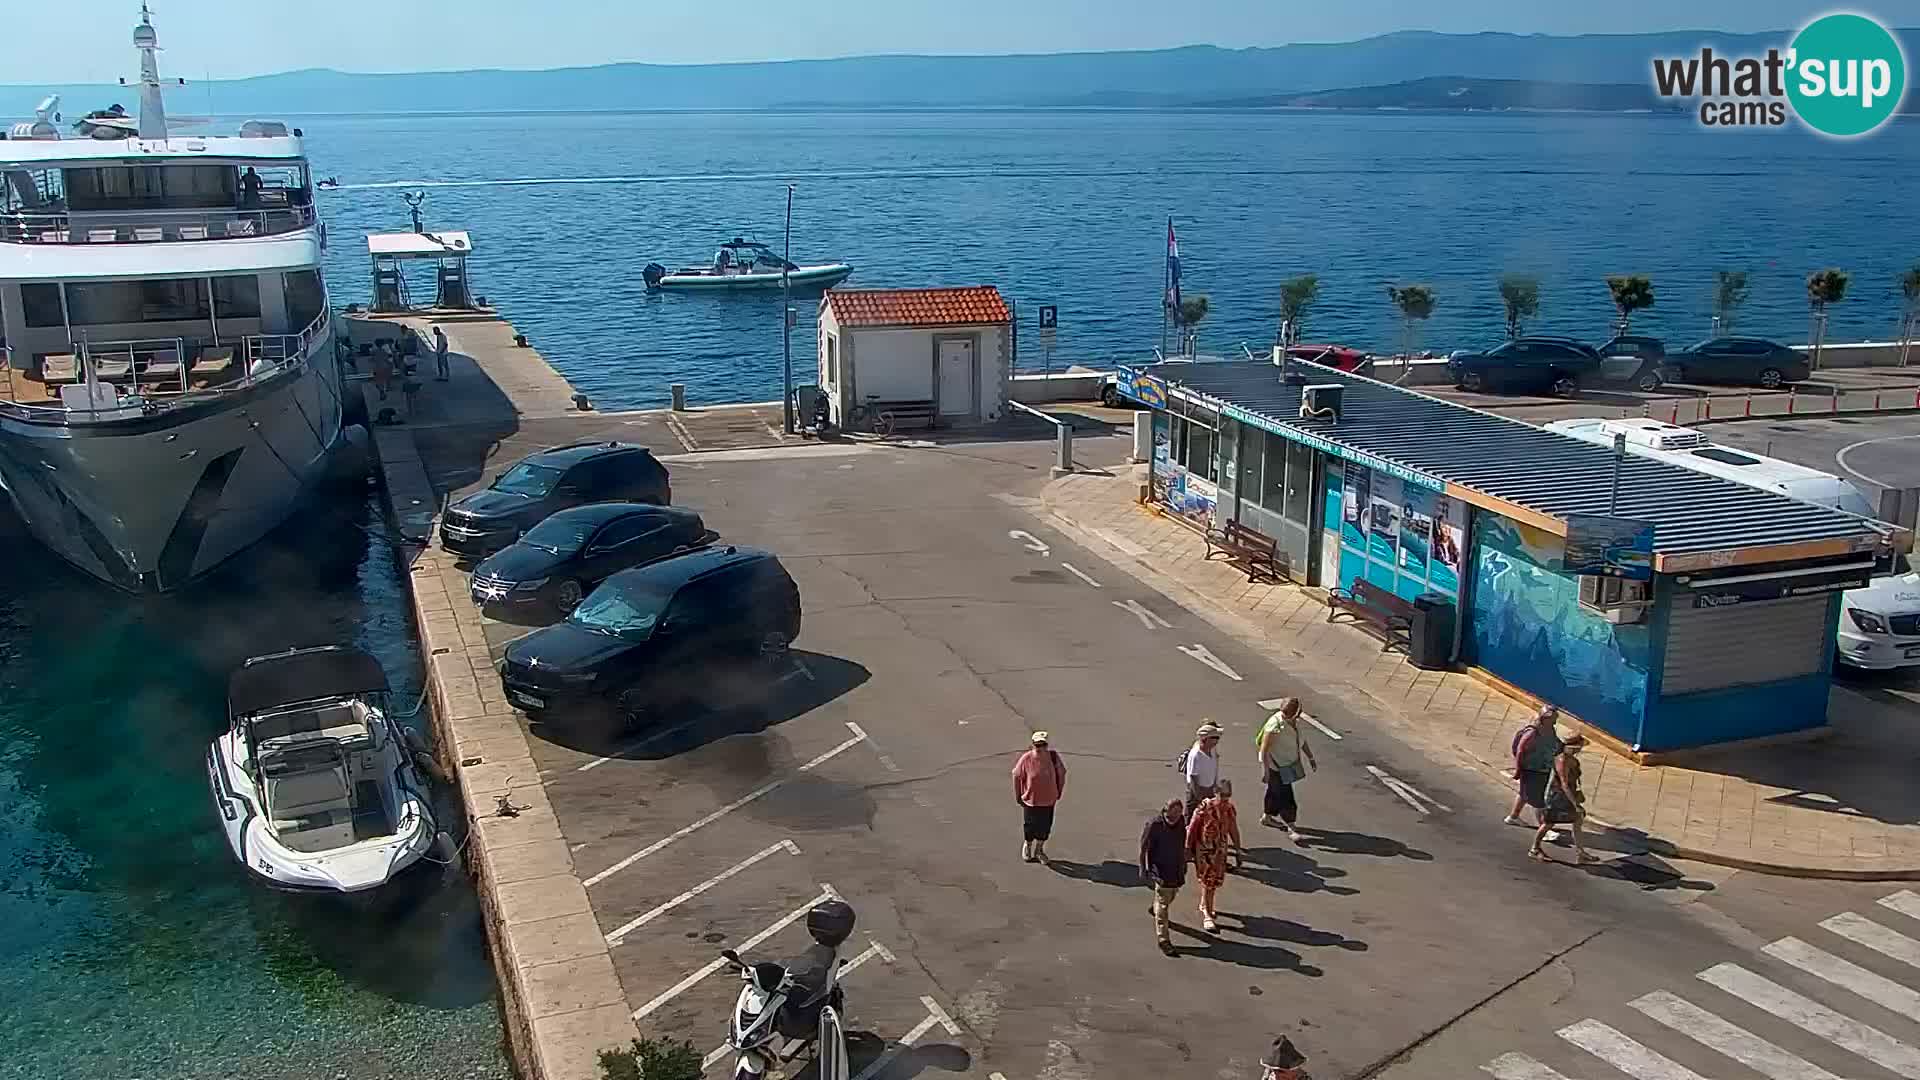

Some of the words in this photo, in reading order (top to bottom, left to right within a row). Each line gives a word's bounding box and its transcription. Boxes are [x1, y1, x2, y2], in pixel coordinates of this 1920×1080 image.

[1043, 308, 1053, 325] P
[1302, 434, 1332, 451] POSTAJA
[1341, 448, 1355, 459] BUS
[1356, 452, 1387, 471] STATION
[1389, 463, 1414, 481] TICKET
[1414, 473, 1442, 490] OFFICE
